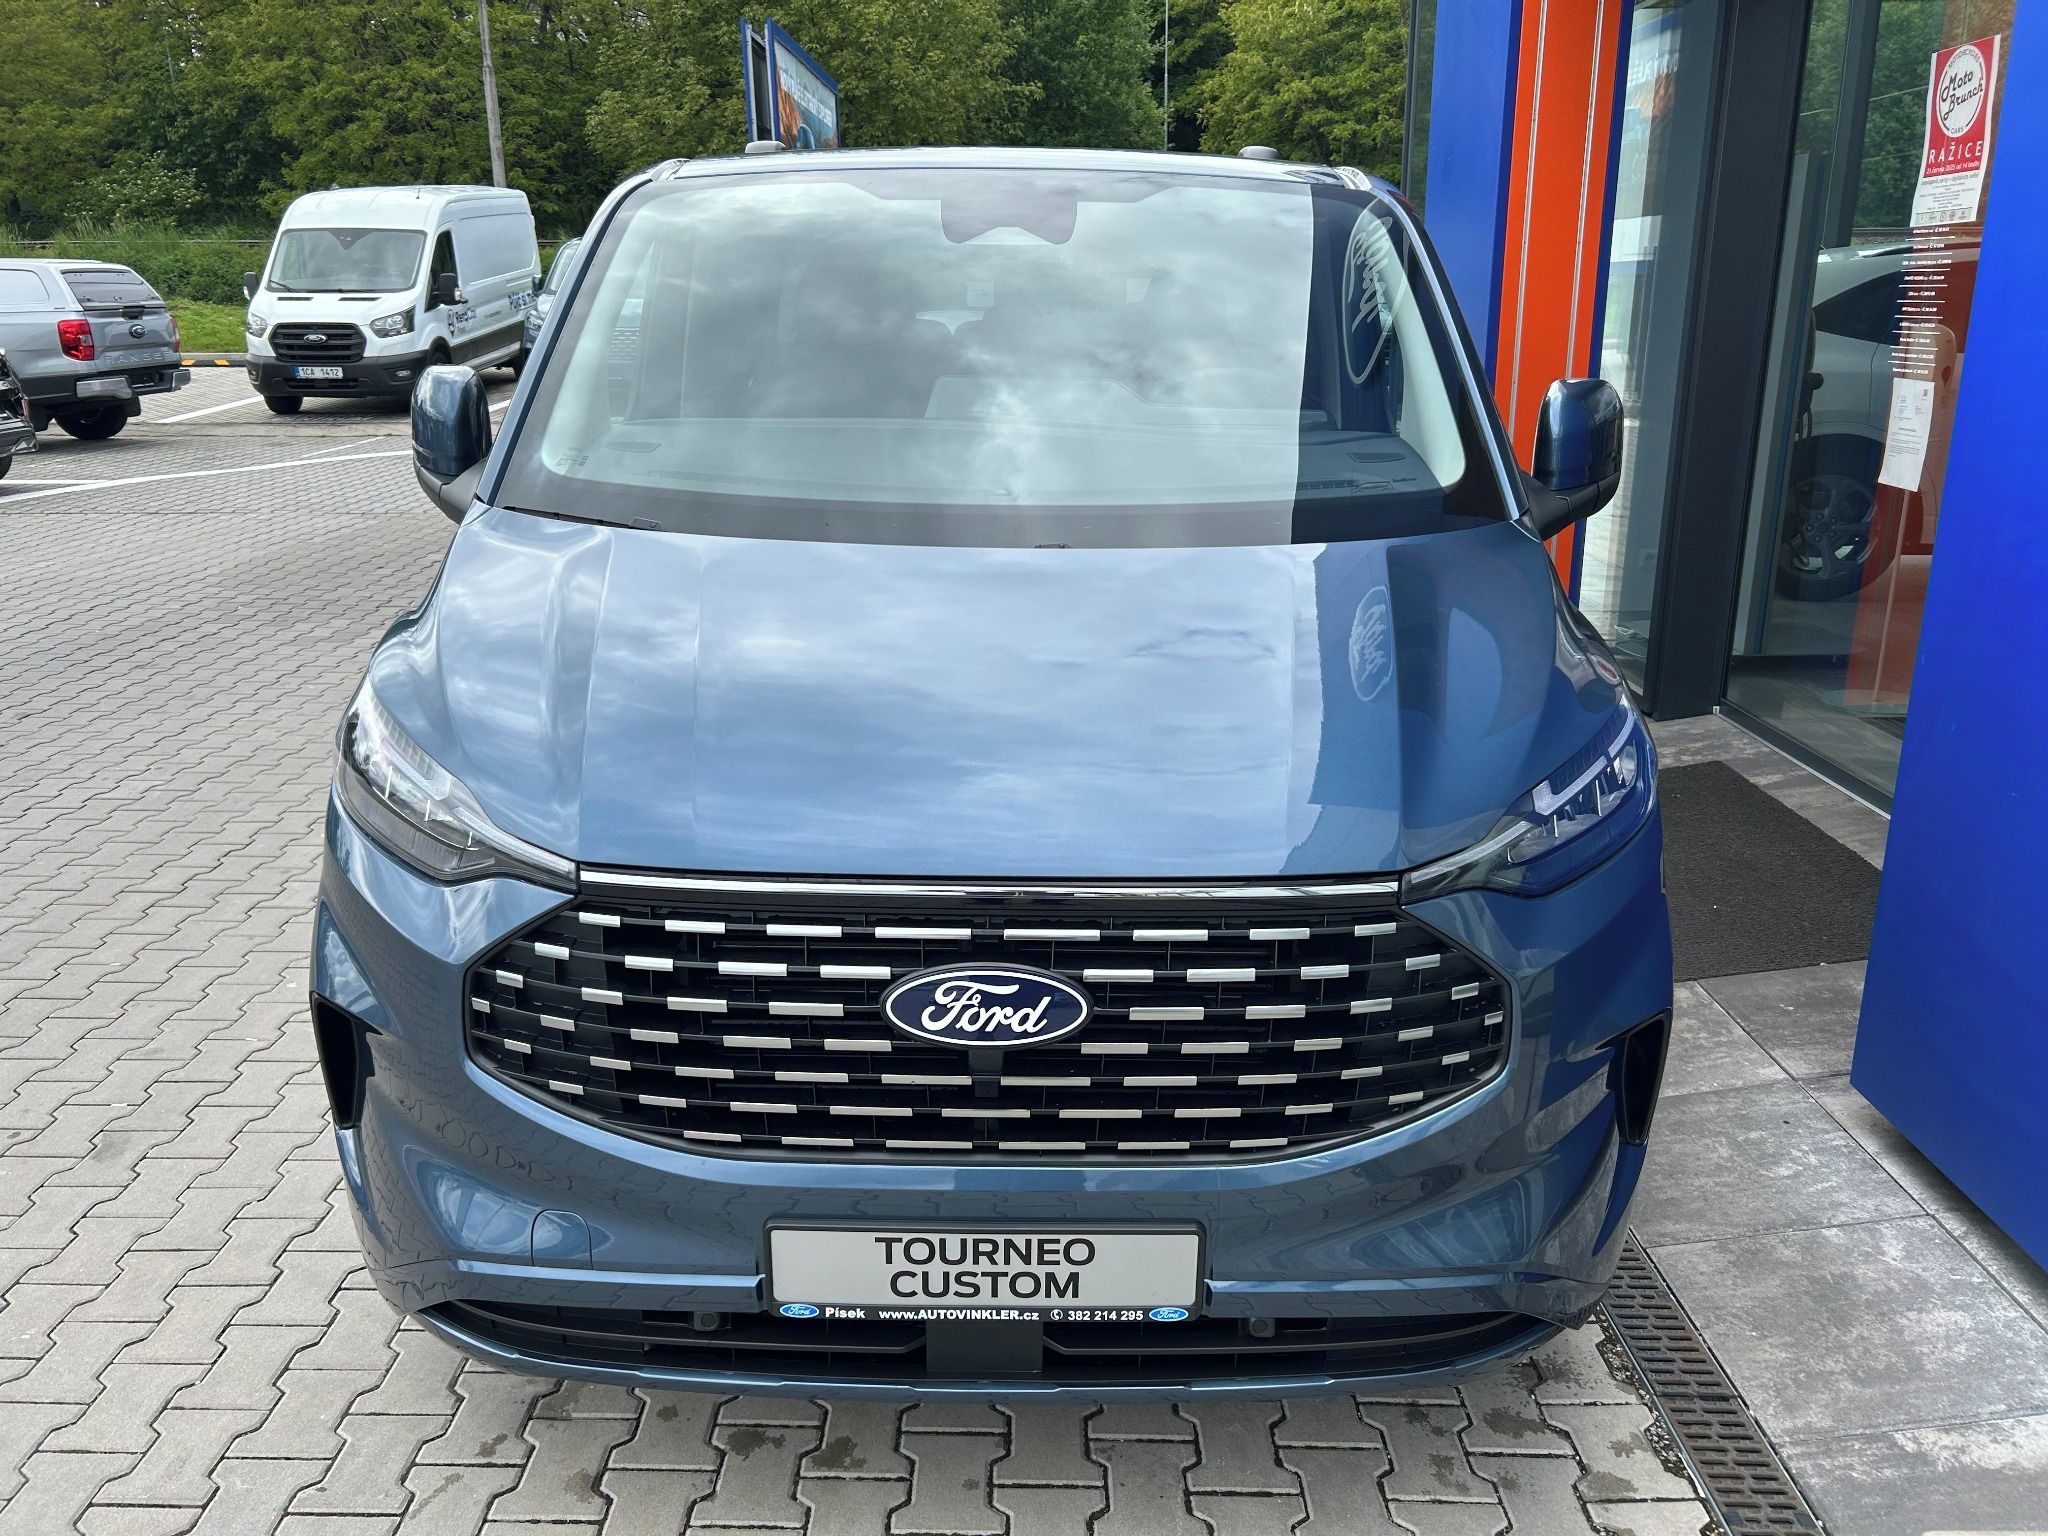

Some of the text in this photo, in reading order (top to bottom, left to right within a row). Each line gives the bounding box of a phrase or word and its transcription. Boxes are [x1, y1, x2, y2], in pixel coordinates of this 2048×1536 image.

[1941, 71, 1974, 103] Moto
[1943, 77, 1984, 122] Brunch
[1950, 126, 1964, 135] CARS
[1928, 140, 1983, 164] RAŽICE
[301, 367, 339, 377] 1CA 1412
[921, 981, 1051, 1033] Ford
[875, 1236, 1096, 1267] TOURNEO
[890, 1270, 1080, 1299] CUSTOM
[825, 1307, 866, 1319] Písek
[879, 1308, 1040, 1321] www.AUTOVINKLER.cz
[1067, 1310, 1091, 1321] 382
[1094, 1310, 1117, 1321] 214
[1120, 1310, 1144, 1321] 295
